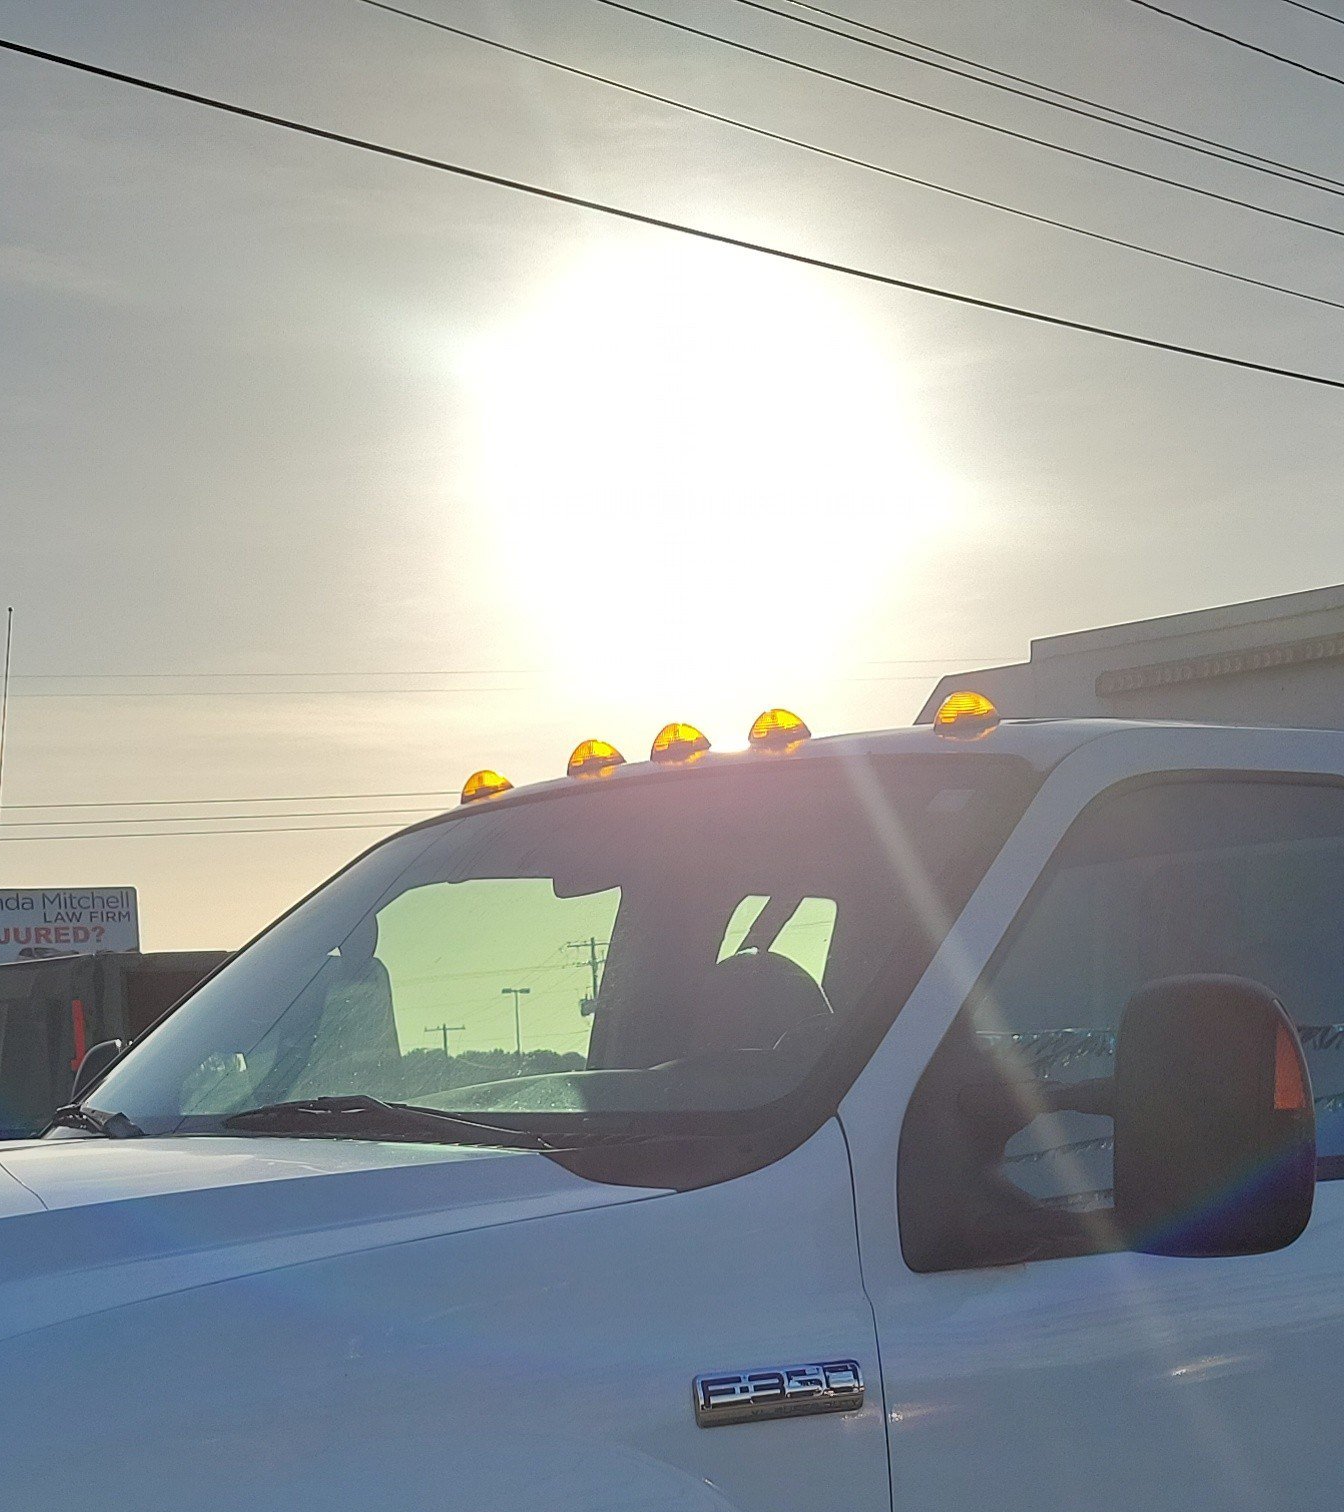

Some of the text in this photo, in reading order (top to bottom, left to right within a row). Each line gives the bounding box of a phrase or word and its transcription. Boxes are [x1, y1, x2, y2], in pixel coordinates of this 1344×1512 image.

[42, 890, 130, 911] Mitchell
[43, 910, 131, 924] LAW FIRM
